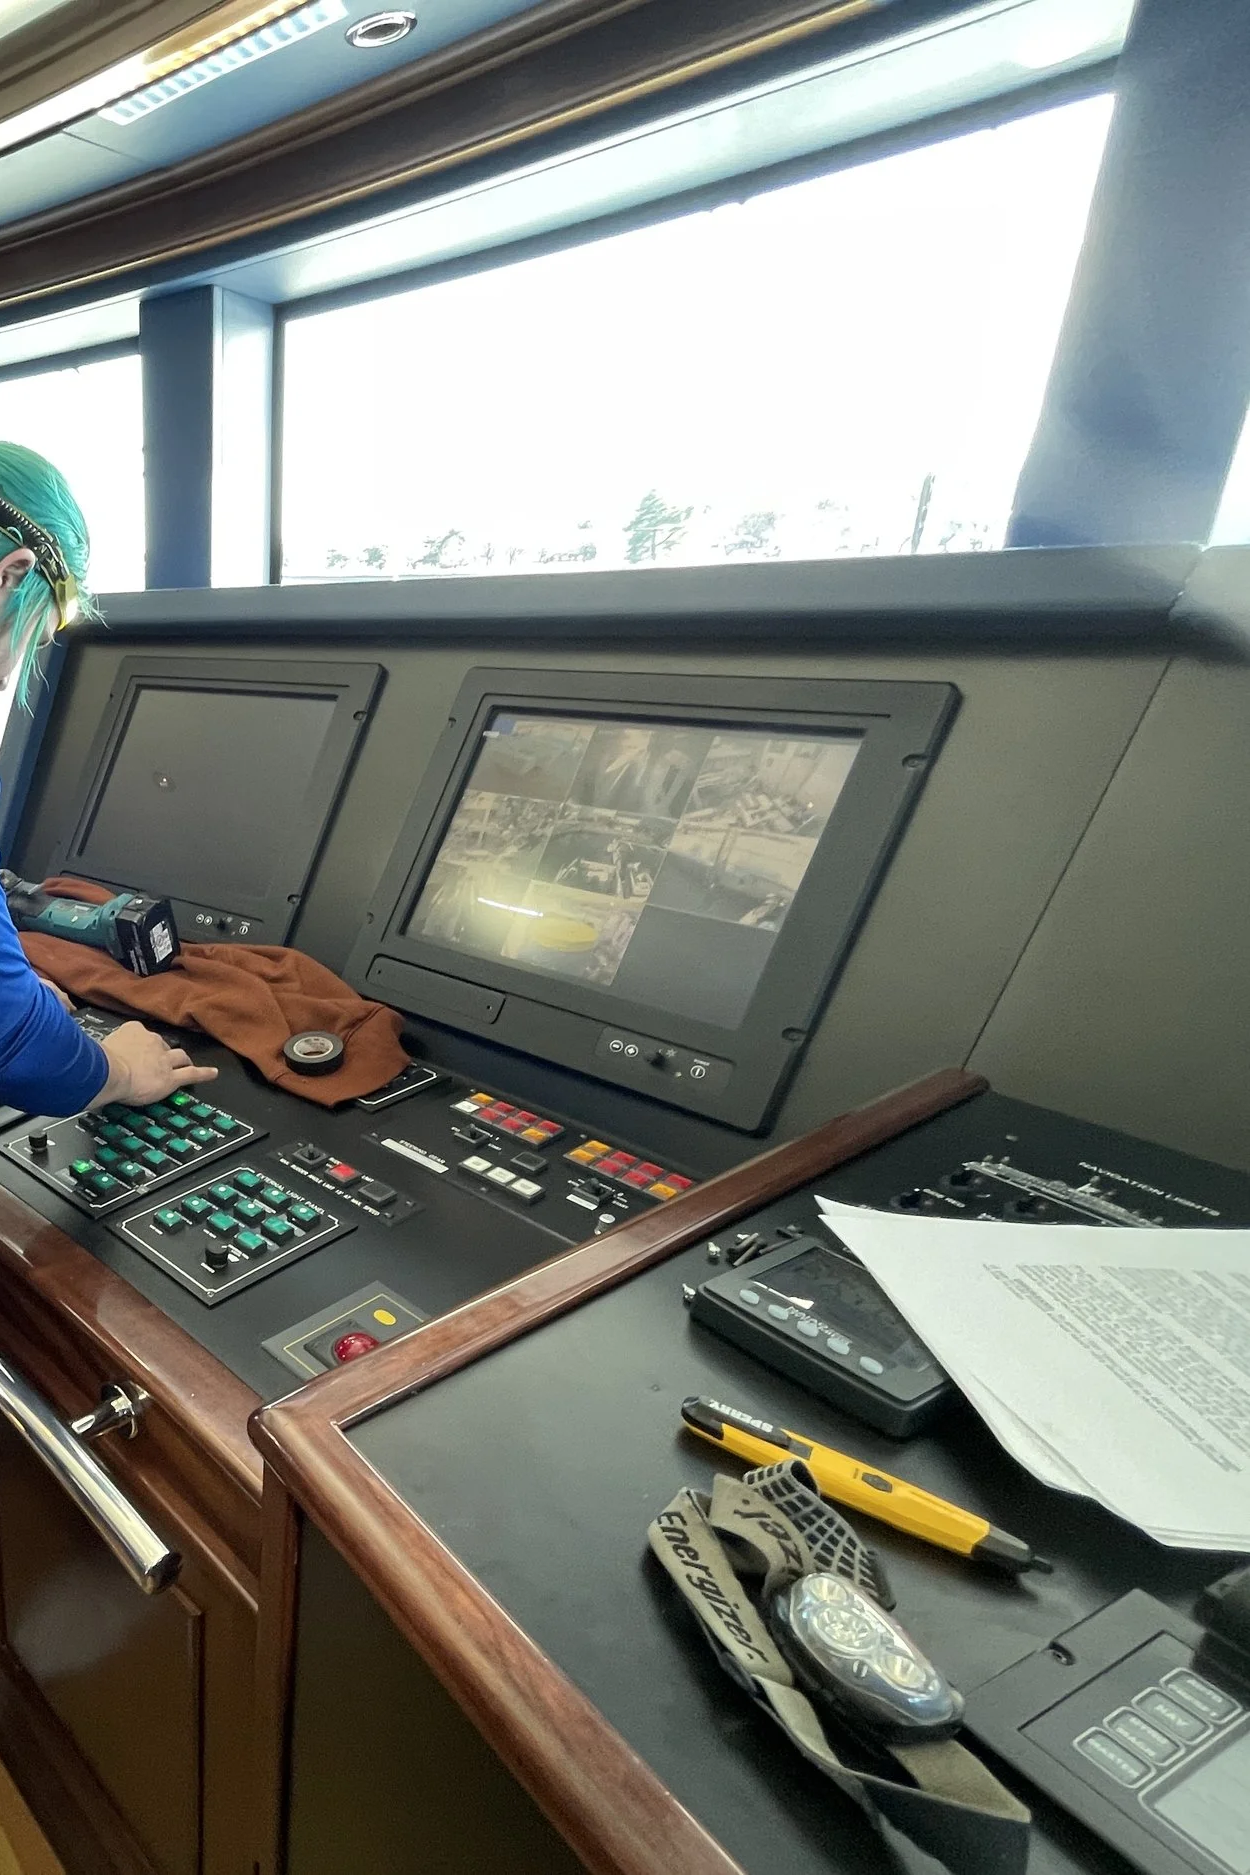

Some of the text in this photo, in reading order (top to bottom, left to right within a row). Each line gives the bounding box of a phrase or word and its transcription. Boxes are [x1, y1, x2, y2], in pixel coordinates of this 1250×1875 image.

[256, 1172, 326, 1216] EXTERNAL LIGHT PANEL
[709, 1399, 774, 1433] SPERRY
